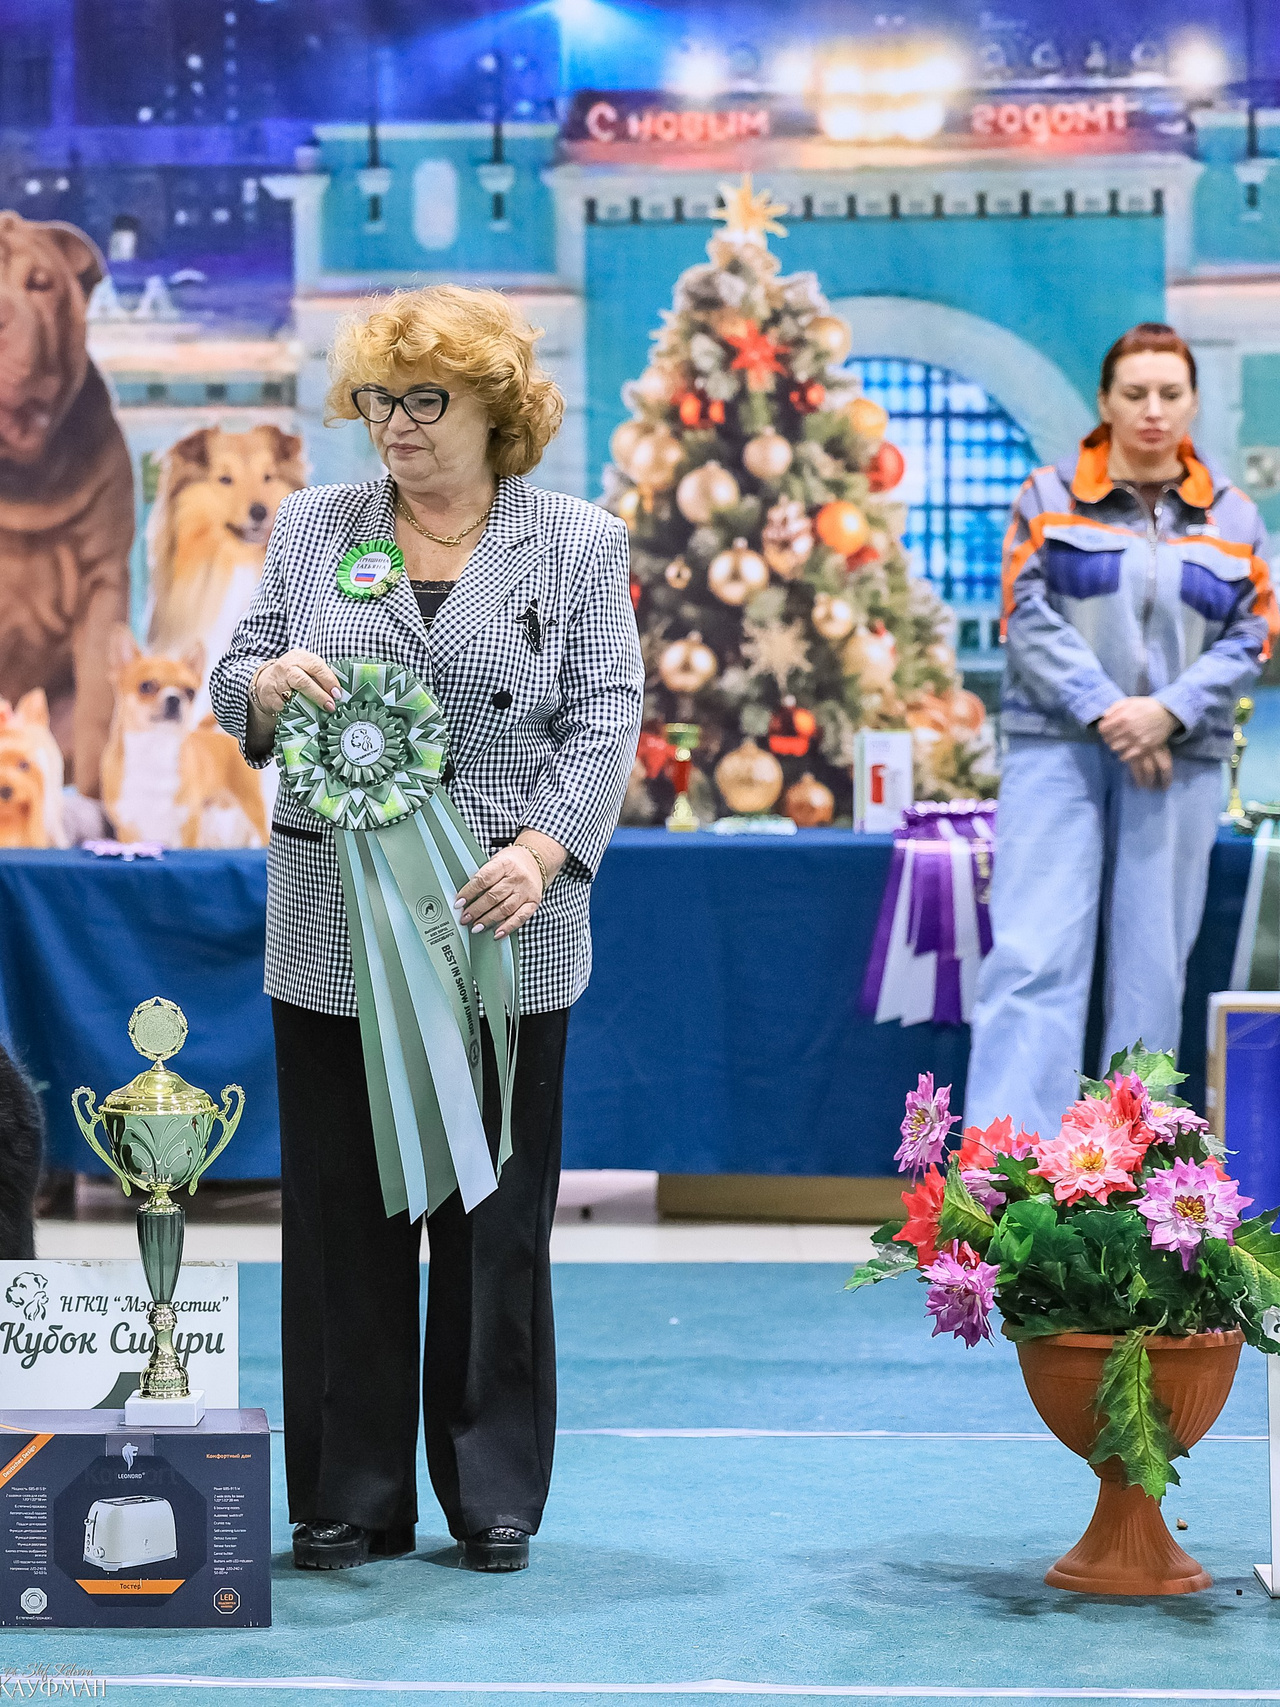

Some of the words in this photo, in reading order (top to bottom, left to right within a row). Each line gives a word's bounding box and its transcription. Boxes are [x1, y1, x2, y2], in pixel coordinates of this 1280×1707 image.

[585, 103, 617, 143] С
[628, 110, 770, 143] новым
[441, 944, 457, 967] BEST
[451, 965, 461, 978] IN
[455, 977, 469, 1004] SHOW
[464, 1004, 475, 1036] JUNIOR
[60, 1296, 109, 1316] НГКЦ
[0, 1321, 98, 1370] Кубок
[110, 1321, 225, 1368] Сиири
[3, 1456, 24, 1478] Deutsches
[21, 1444, 37, 1460] Design
[220, 1593, 234, 1601] LED
